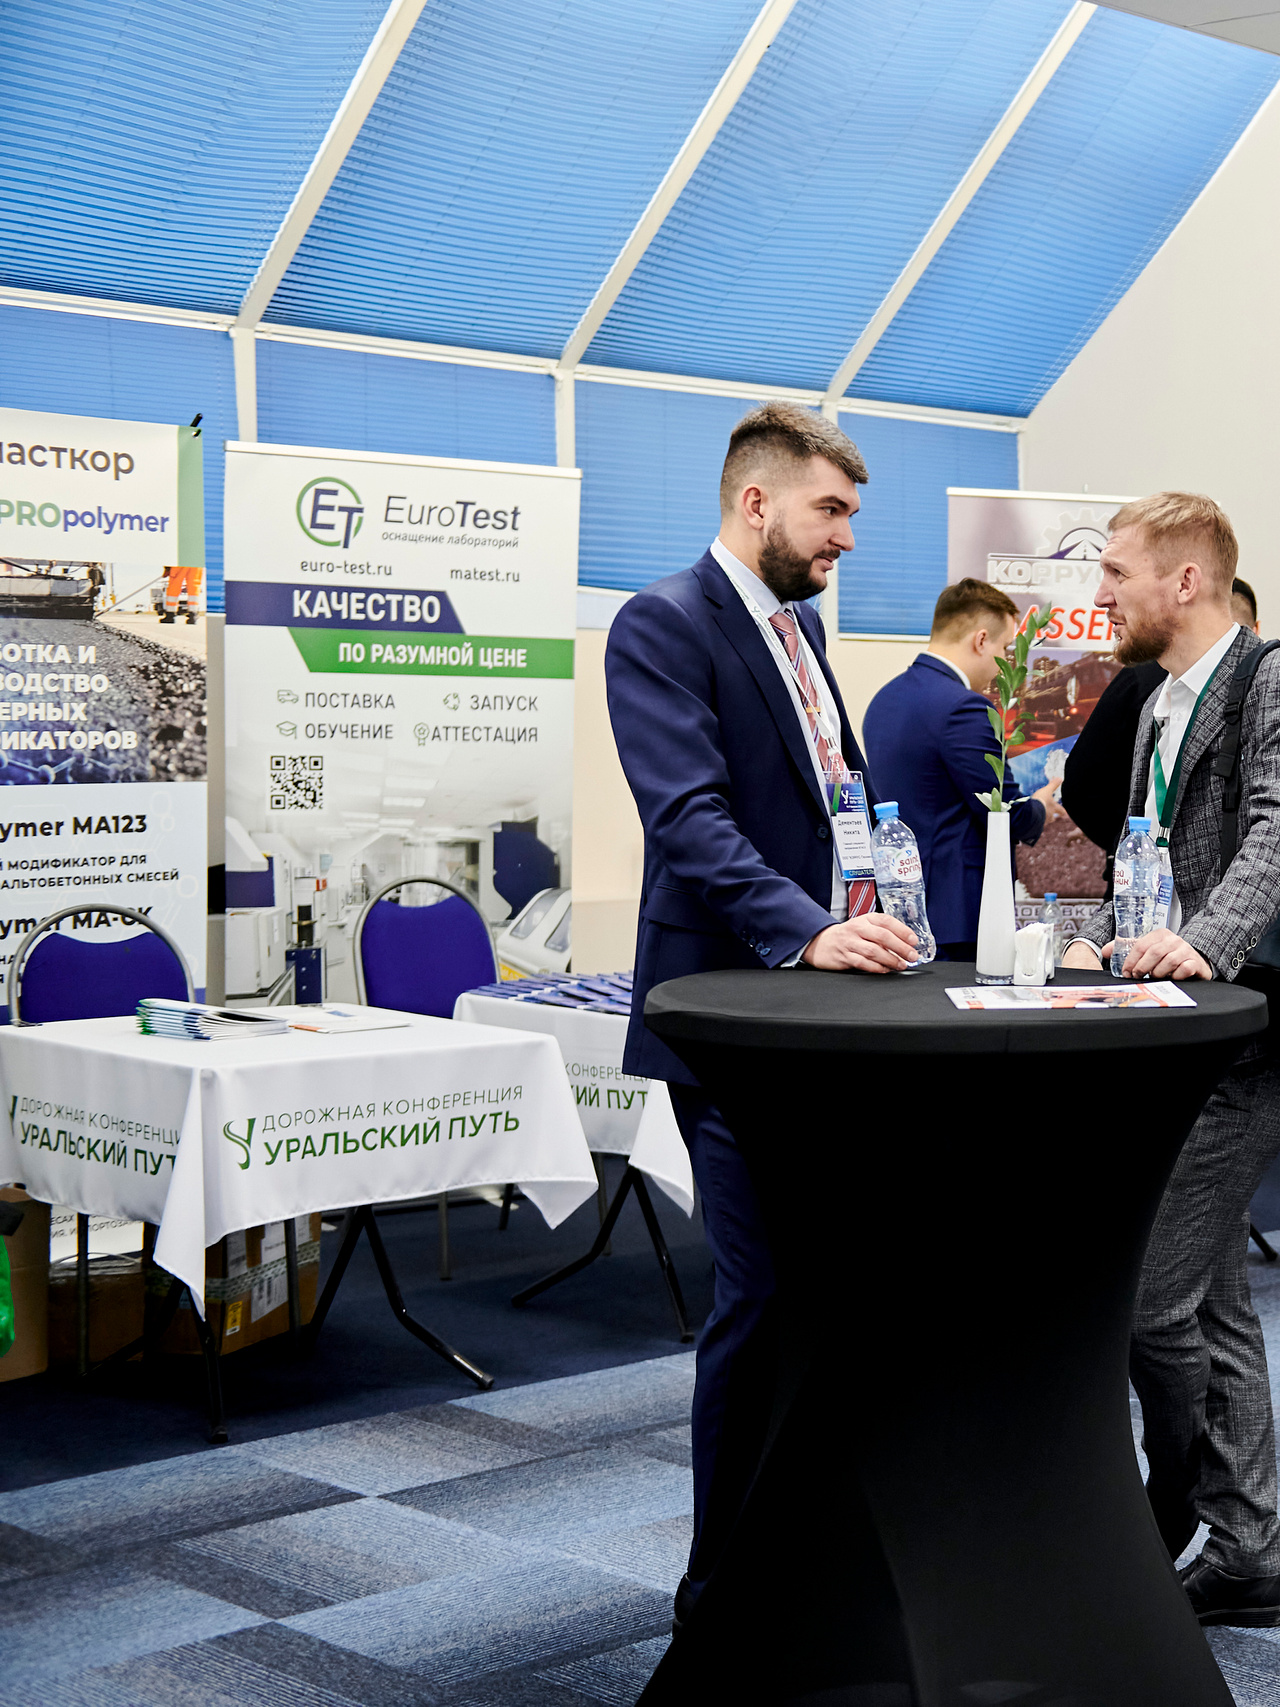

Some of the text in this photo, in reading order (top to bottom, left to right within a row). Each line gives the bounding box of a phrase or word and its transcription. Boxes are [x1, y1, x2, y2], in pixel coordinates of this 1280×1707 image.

[0, 442, 135, 481] асткор
[384, 495, 521, 531] EuroTest
[382, 531, 519, 549] оснащение лабораторий
[300, 559, 393, 577] euro-test.ru
[450, 567, 521, 583] matest.ru
[292, 589, 441, 624] КАЧЕСТВО
[1014, 604, 1114, 641] ASSE
[0, 643, 97, 665] ОТКА И
[338, 642, 528, 671] ПО РАЗУМНОЙ ЦЕНЕ
[0, 672, 110, 695] ОДСТВО
[305, 692, 396, 709] ПОСТАВКА
[470, 695, 539, 712] ЗАПУСК
[305, 723, 394, 740] ОБУЧЕНИЕ
[431, 726, 539, 745] АТТЕСТАЦИЯ
[72, 814, 148, 835] MA123
[8, 854, 147, 872] МОДИФИКАТОР ДЛЯ
[1, 868, 180, 890] АЛЬТОБЕТОННЫХ СМЕСЕЙ
[262, 1085, 524, 1134] ДОРОЖНАЯ КОНФЕРЕНЦИЯ
[606, 1088, 649, 1110] ПУТ
[20, 1097, 182, 1147] ДОРОЖНАЯ КОНФЕРЕНЦИ
[20, 1121, 177, 1176] УРАЛЬСКИЙ ПУТ
[263, 1110, 521, 1166] УРАЛЬСКИЙ ПУТЬ
